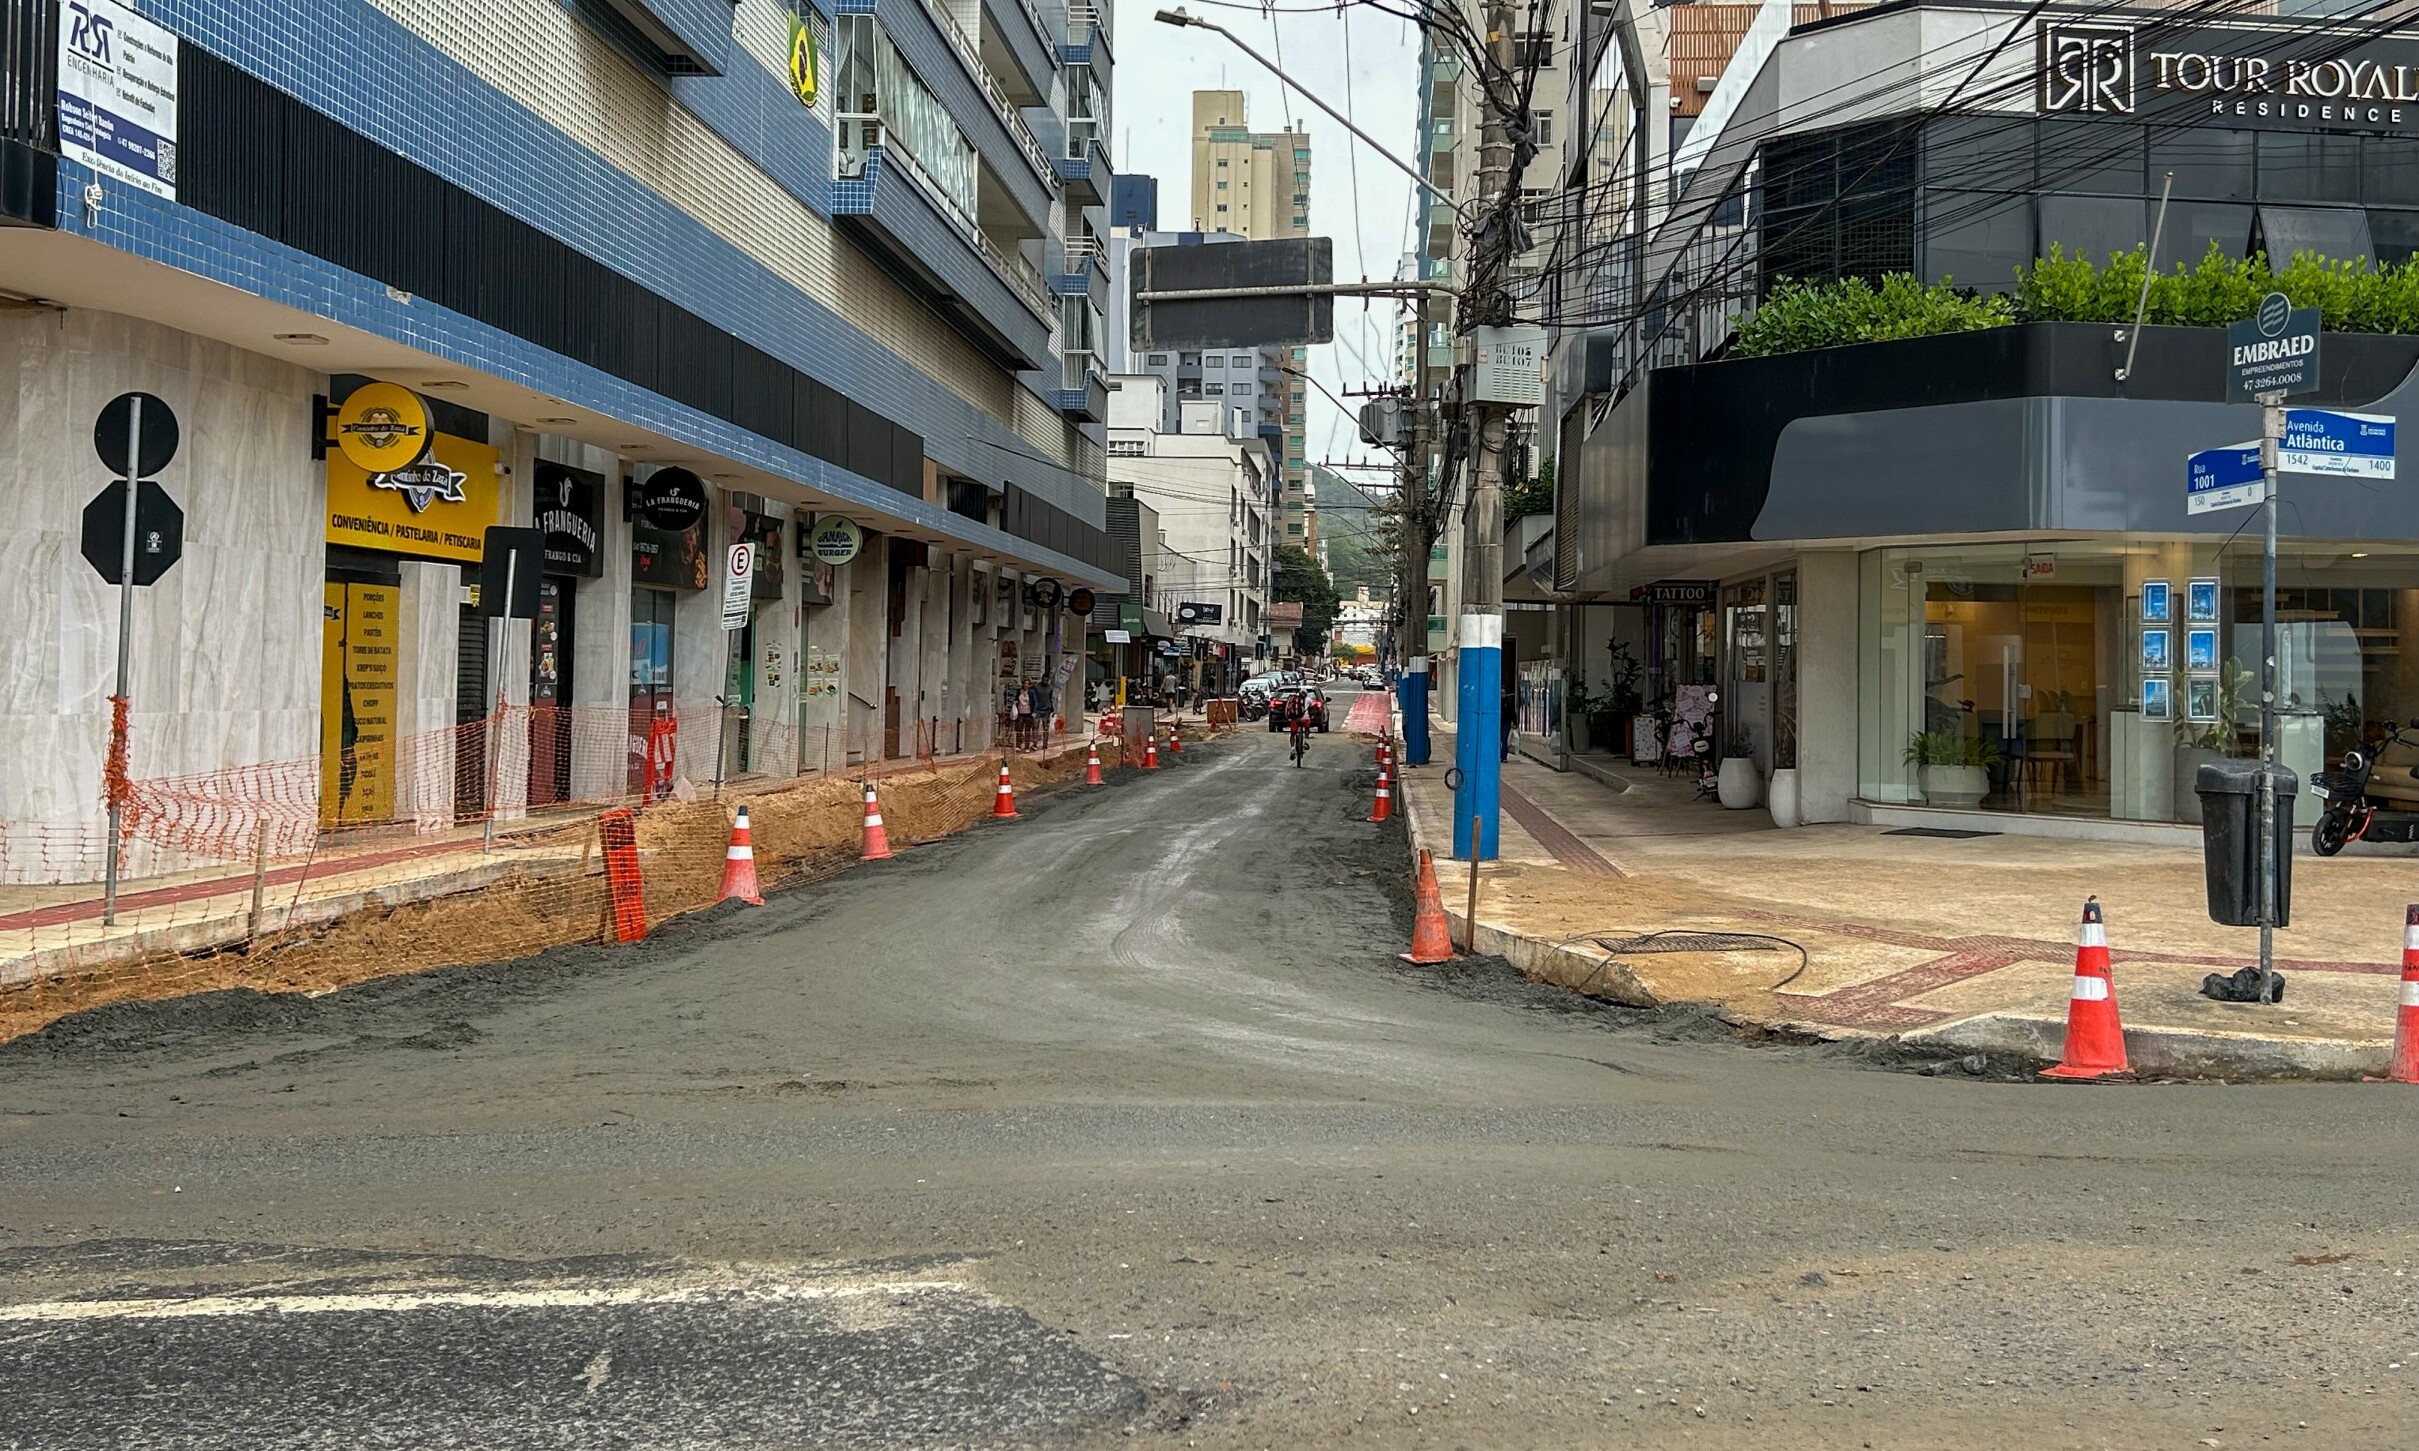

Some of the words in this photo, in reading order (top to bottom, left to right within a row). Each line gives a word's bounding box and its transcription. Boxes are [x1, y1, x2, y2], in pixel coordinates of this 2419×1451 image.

[67, 55, 114, 88] ENGENHARIA
[2150, 52, 2274, 94] TOUR
[2286, 58, 2419, 101] ROYAL
[2212, 100, 2401, 123] RESIDENCE
[2233, 334, 2315, 366] EMBRAED
[2241, 359, 2304, 376] EMPREENDIMENTOS
[2243, 380, 2254, 391] 47
[2254, 373, 2302, 389] 3264.0008
[2287, 420, 2324, 433] Avenida
[2286, 434, 2345, 452] Atlântica
[2194, 464, 2206, 475] Rua
[2286, 454, 2309, 466] 1542
[2369, 459, 2391, 472] 1400
[422, 469, 431, 482] do
[432, 469, 448, 487] Zazá
[2194, 474, 2215, 491] 1001
[2247, 486, 2252, 497] 0
[645, 498, 656, 507] LA
[657, 496, 700, 510] FRANGUERIA
[331, 513, 389, 537] CONVENIÊNCIA
[396, 524, 439, 544] PASTELARIA
[444, 533, 481, 550] PETISCARIA
[543, 509, 596, 554] FRANGUERIA
[544, 549, 567, 562] FRANGO
[571, 553, 582, 564] CIA
[736, 552, 745, 570] E
[818, 549, 852, 557] BURGER
[363, 592, 385, 604] PORÇÕES
[1654, 587, 1705, 600] TATTOO
[363, 611, 384, 620] LANCHES
[374, 645, 392, 655] BATATA
[363, 699, 379, 708] CHOPP
[366, 716, 387, 725] NATURAL
